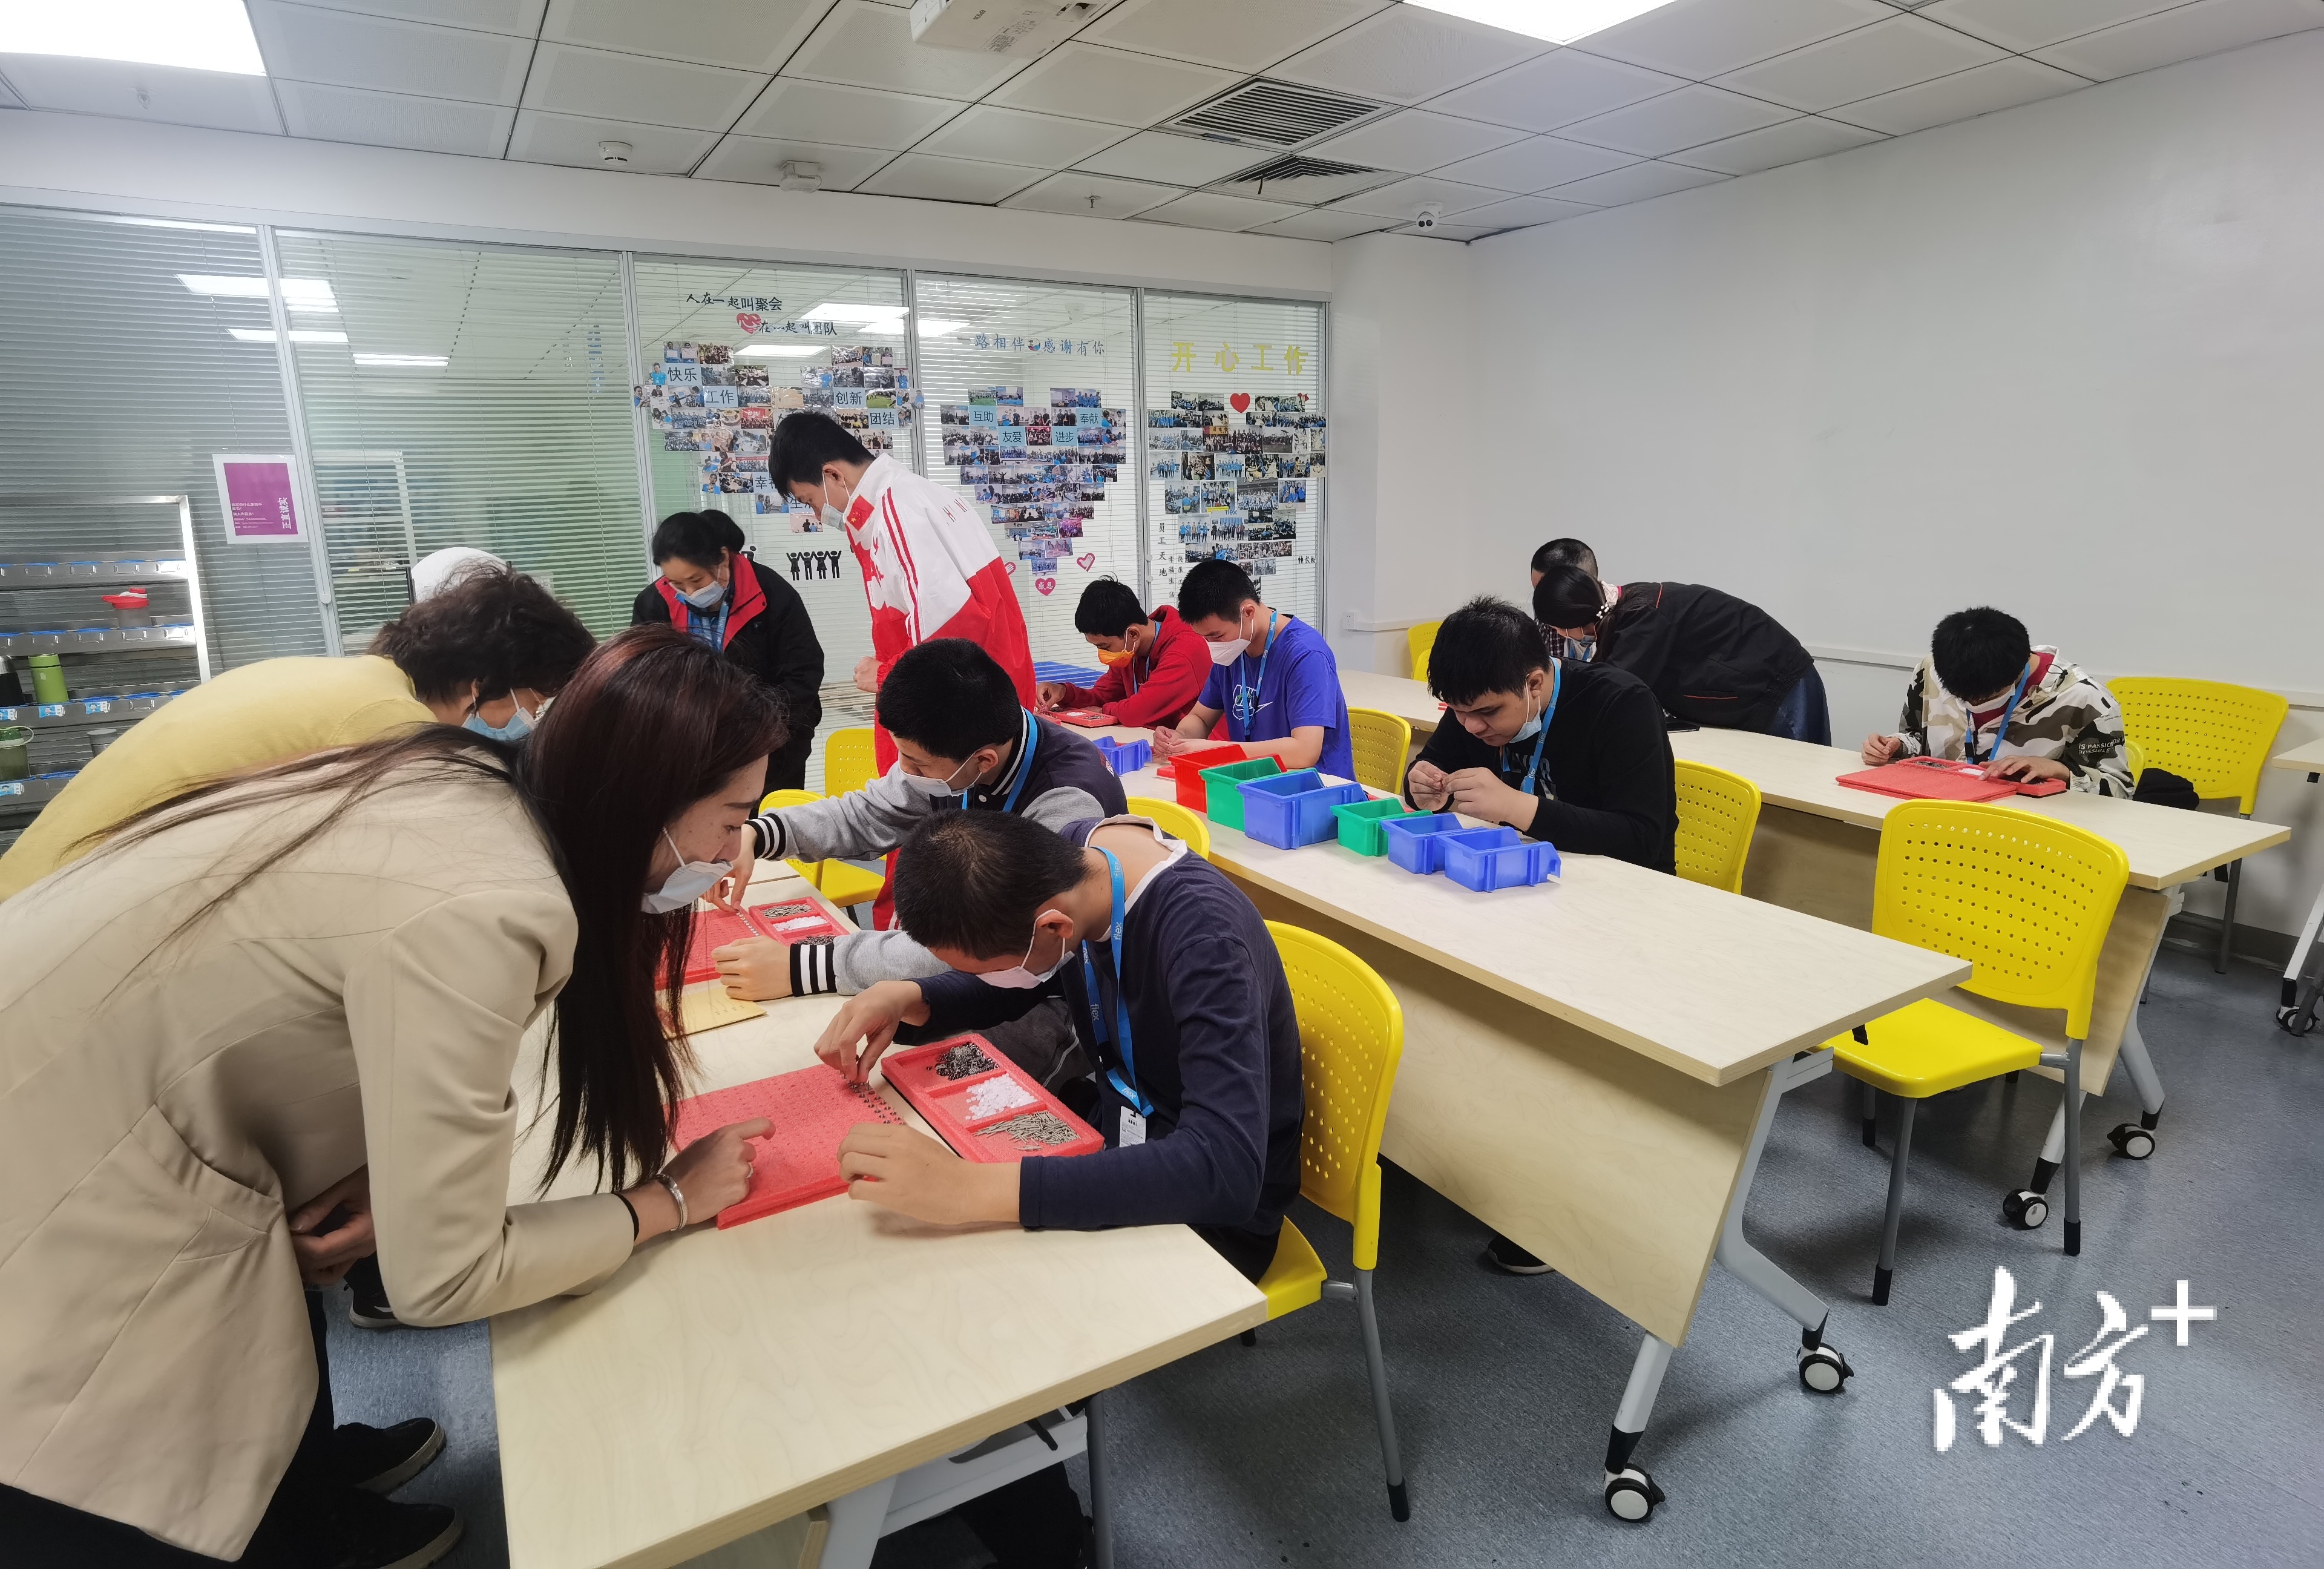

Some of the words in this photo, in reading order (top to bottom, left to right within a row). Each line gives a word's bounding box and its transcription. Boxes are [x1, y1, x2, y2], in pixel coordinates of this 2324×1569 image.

[686, 292, 783, 312] 人在一起叫聚会
[957, 333, 1025, 351] 一路相伴
[1043, 338, 1105, 356] 感谢有你
[1172, 341, 1309, 375] 开心工作
[668, 366, 697, 383] 快乐
[706, 389, 735, 405] 工作
[836, 390, 862, 406] 创新
[870, 412, 894, 425] 团结
[973, 411, 993, 423] 互助
[1080, 413, 1098, 424] 奉献
[1002, 432, 1022, 442] 友爱
[1055, 432, 1074, 442] 进步
[278, 497, 292, 530] 正直诚实
[1157, 522, 1167, 576] 员工天地
[1038, 582, 1054, 590] 感恩
[1113, 921, 1122, 940] flex
[1091, 1003, 1100, 1021] flex
